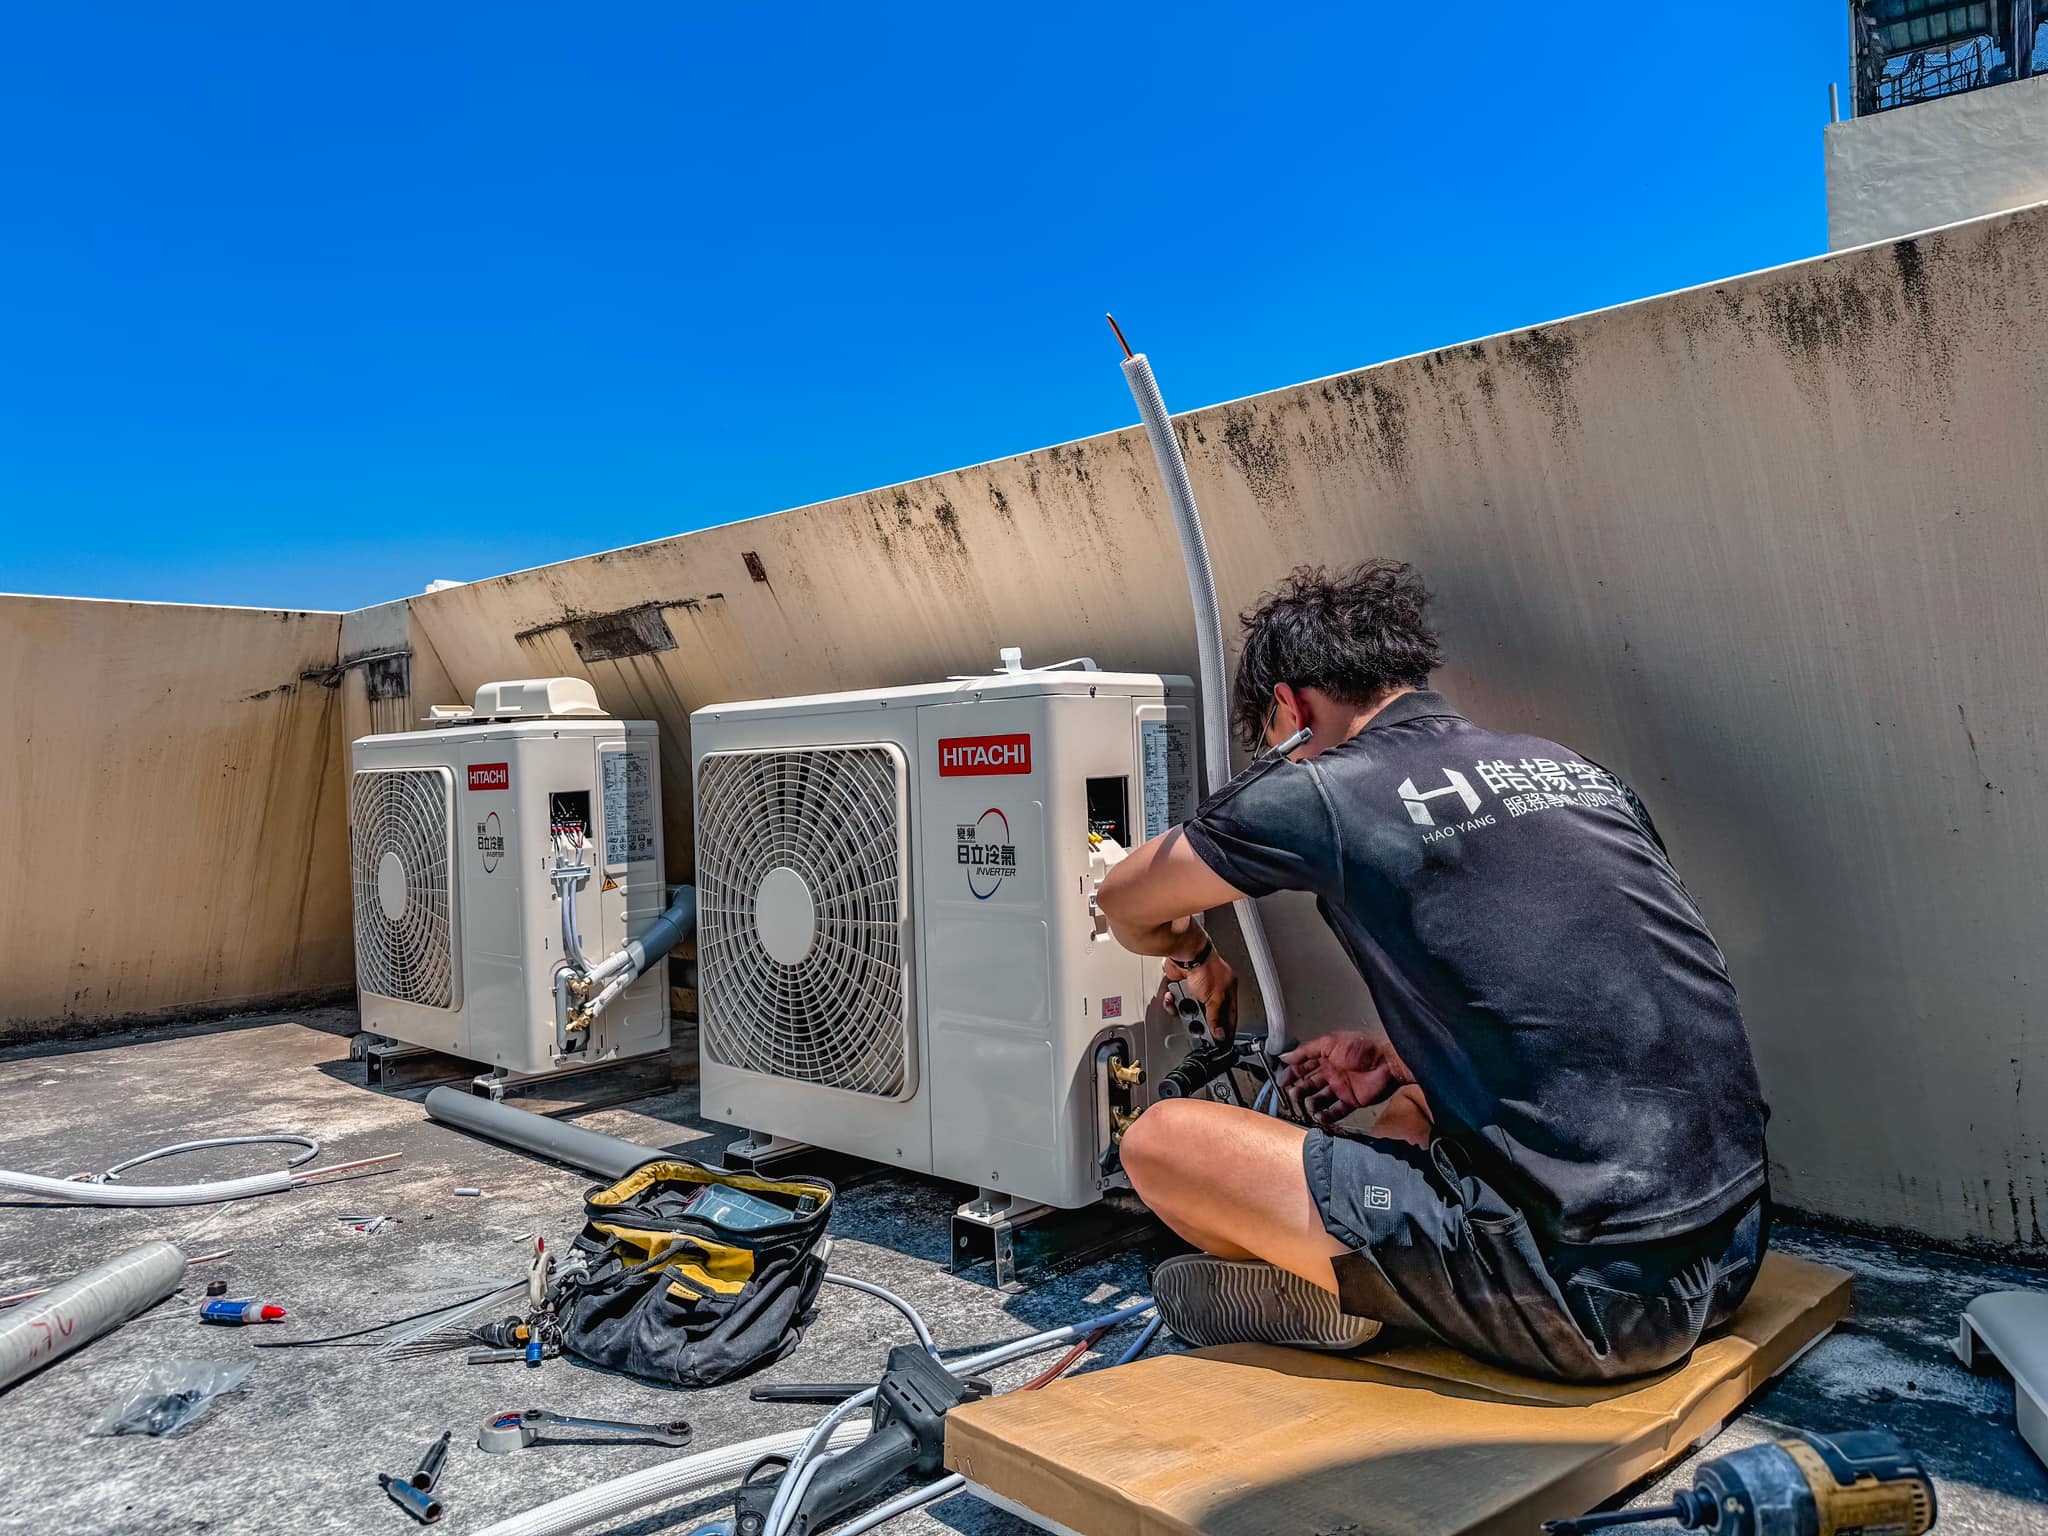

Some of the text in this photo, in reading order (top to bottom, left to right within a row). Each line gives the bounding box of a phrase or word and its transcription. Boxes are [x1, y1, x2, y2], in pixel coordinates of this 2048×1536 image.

[943, 744, 1025, 767] HITACHI
[469, 769, 506, 785] HITACHI
[1421, 813, 1497, 845] HAO YANG
[957, 843, 1016, 867] 日立冷氣
[975, 866, 1016, 877] INVERTER
